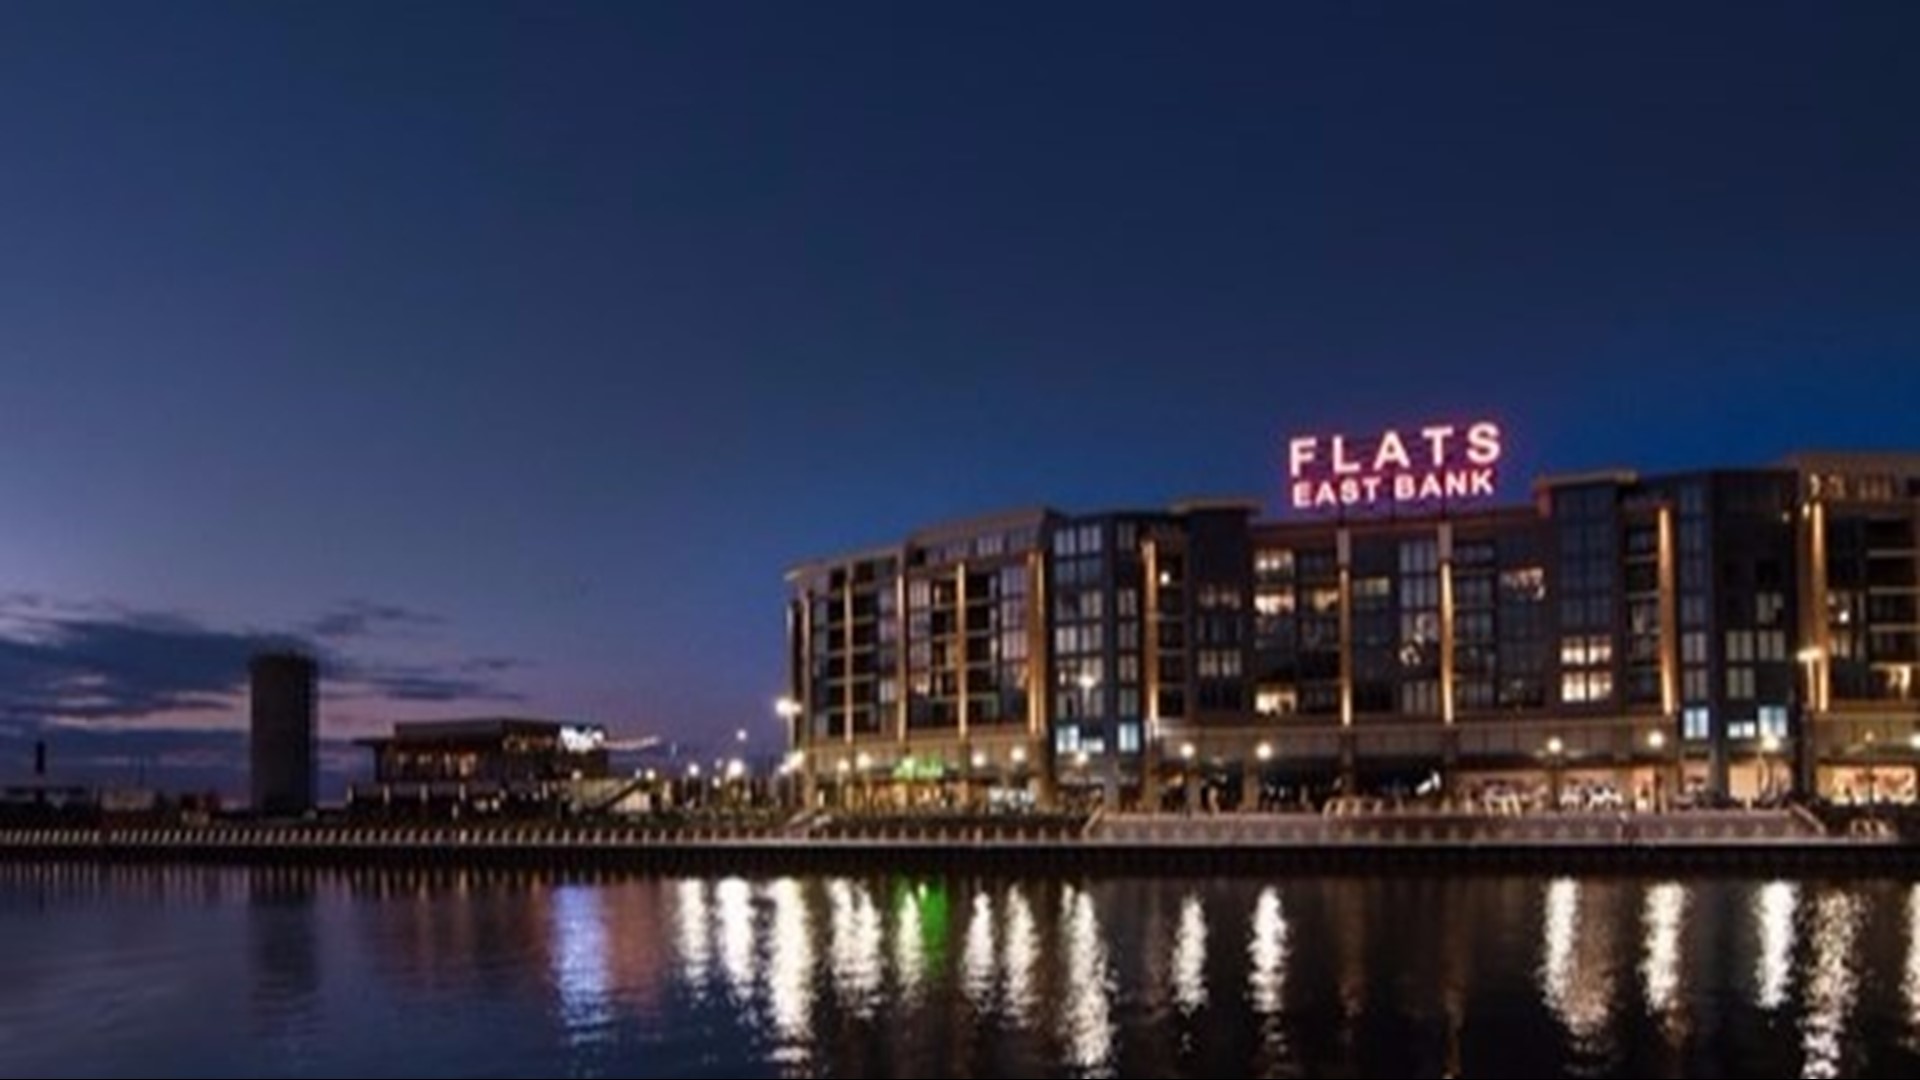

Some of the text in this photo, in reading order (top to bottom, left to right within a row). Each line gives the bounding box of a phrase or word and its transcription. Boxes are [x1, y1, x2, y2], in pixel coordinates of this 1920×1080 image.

[1289, 422, 1501, 477] FLATS
[1293, 469, 1494, 508] EAST BANK
